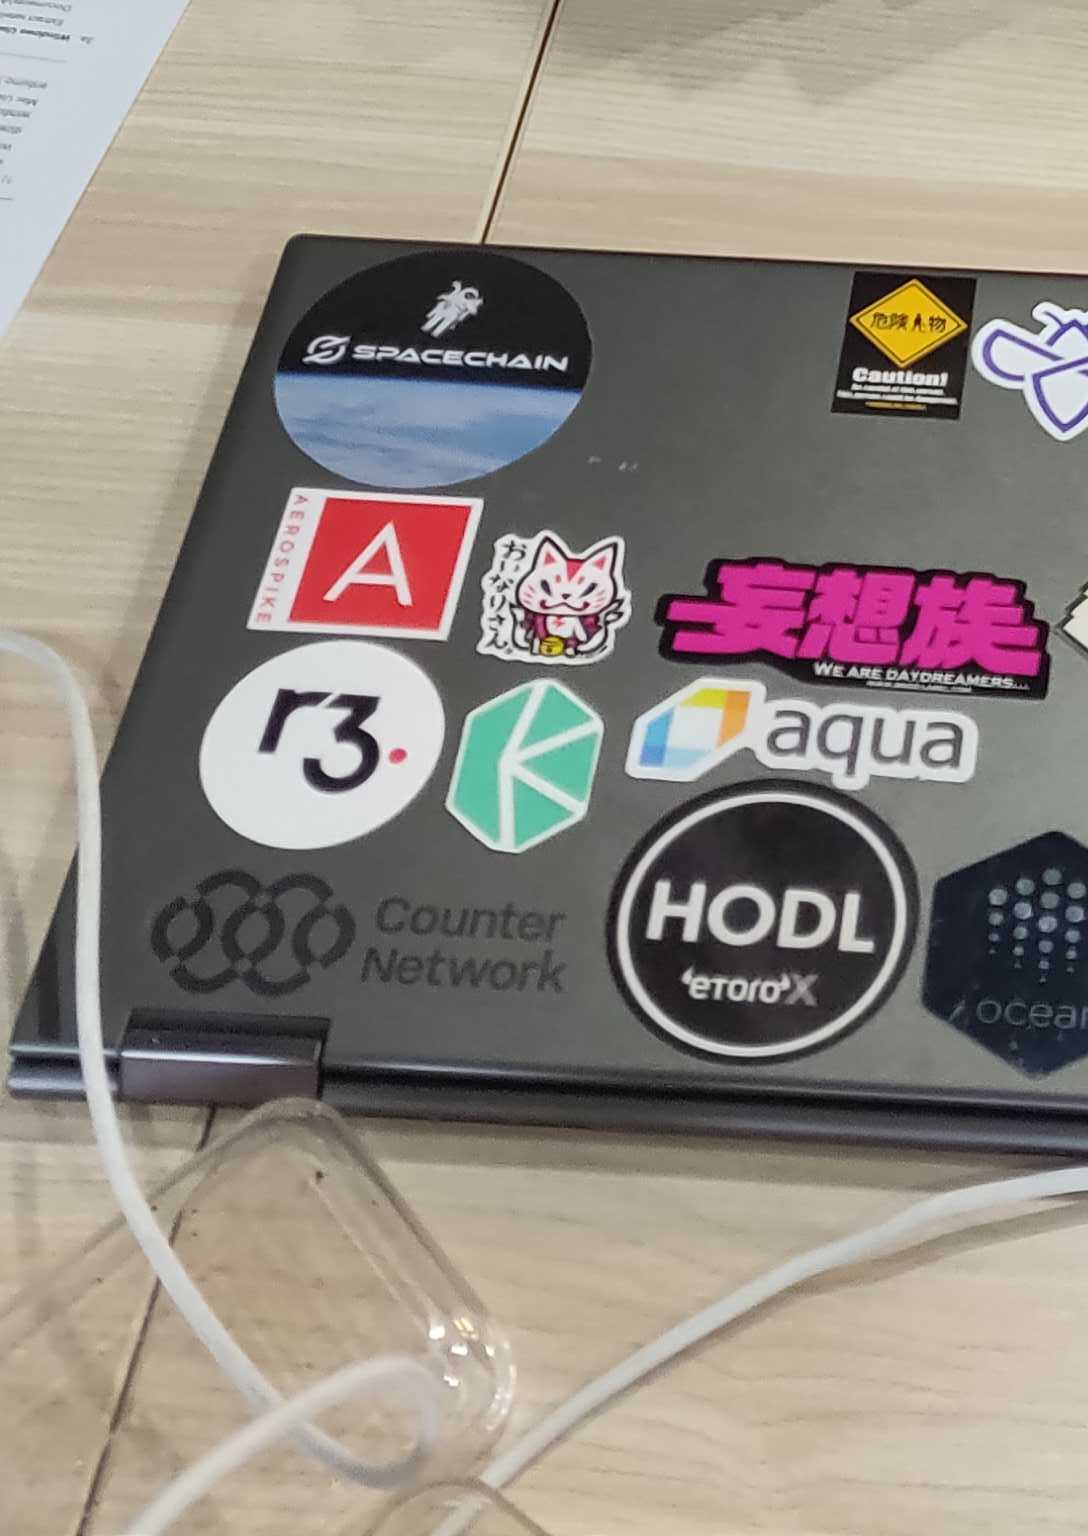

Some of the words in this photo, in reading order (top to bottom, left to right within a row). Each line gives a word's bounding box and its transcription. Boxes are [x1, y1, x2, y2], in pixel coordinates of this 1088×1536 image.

[352, 344, 569, 373] SPACECHAIN
[852, 367, 949, 388] Caution!
[255, 494, 308, 624] AEROSPIKE
[322, 519, 414, 608] A
[846, 666, 883, 681] ARE
[766, 709, 965, 775] aqua
[375, 896, 567, 941] Counter
[646, 880, 876, 954] HODL
[361, 947, 567, 993] Network
